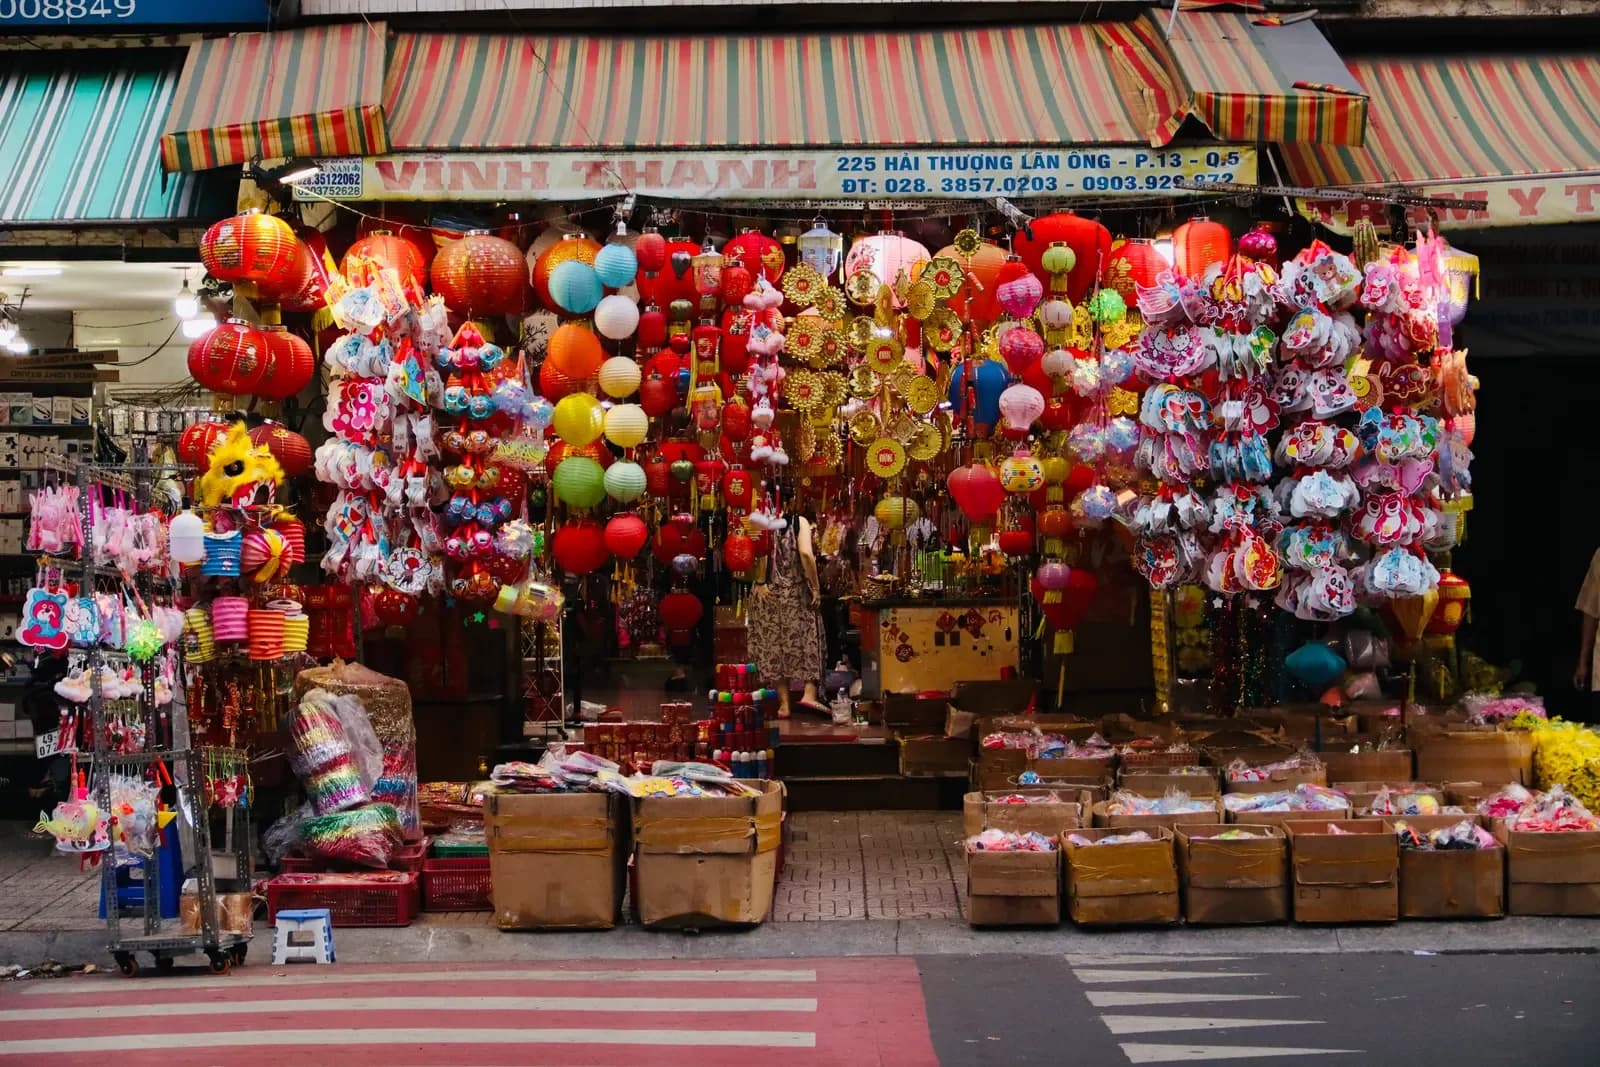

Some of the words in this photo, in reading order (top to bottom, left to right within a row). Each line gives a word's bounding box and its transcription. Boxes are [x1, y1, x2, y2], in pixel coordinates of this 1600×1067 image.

[837, 156, 876, 171] 225
[884, 152, 919, 171] HẢI
[927, 153, 1013, 173] THƯỢNG
[1021, 152, 1060, 170] LÃN
[1067, 151, 1111, 169] ÔNG
[1135, 153, 1182, 169] P.13
[1206, 151, 1240, 168] Q.5
[841, 178, 877, 193] ĐT:
[885, 178, 933, 193] 028.
[941, 176, 1058, 192] 3857.0203
[1508, 186, 1546, 216] Y
